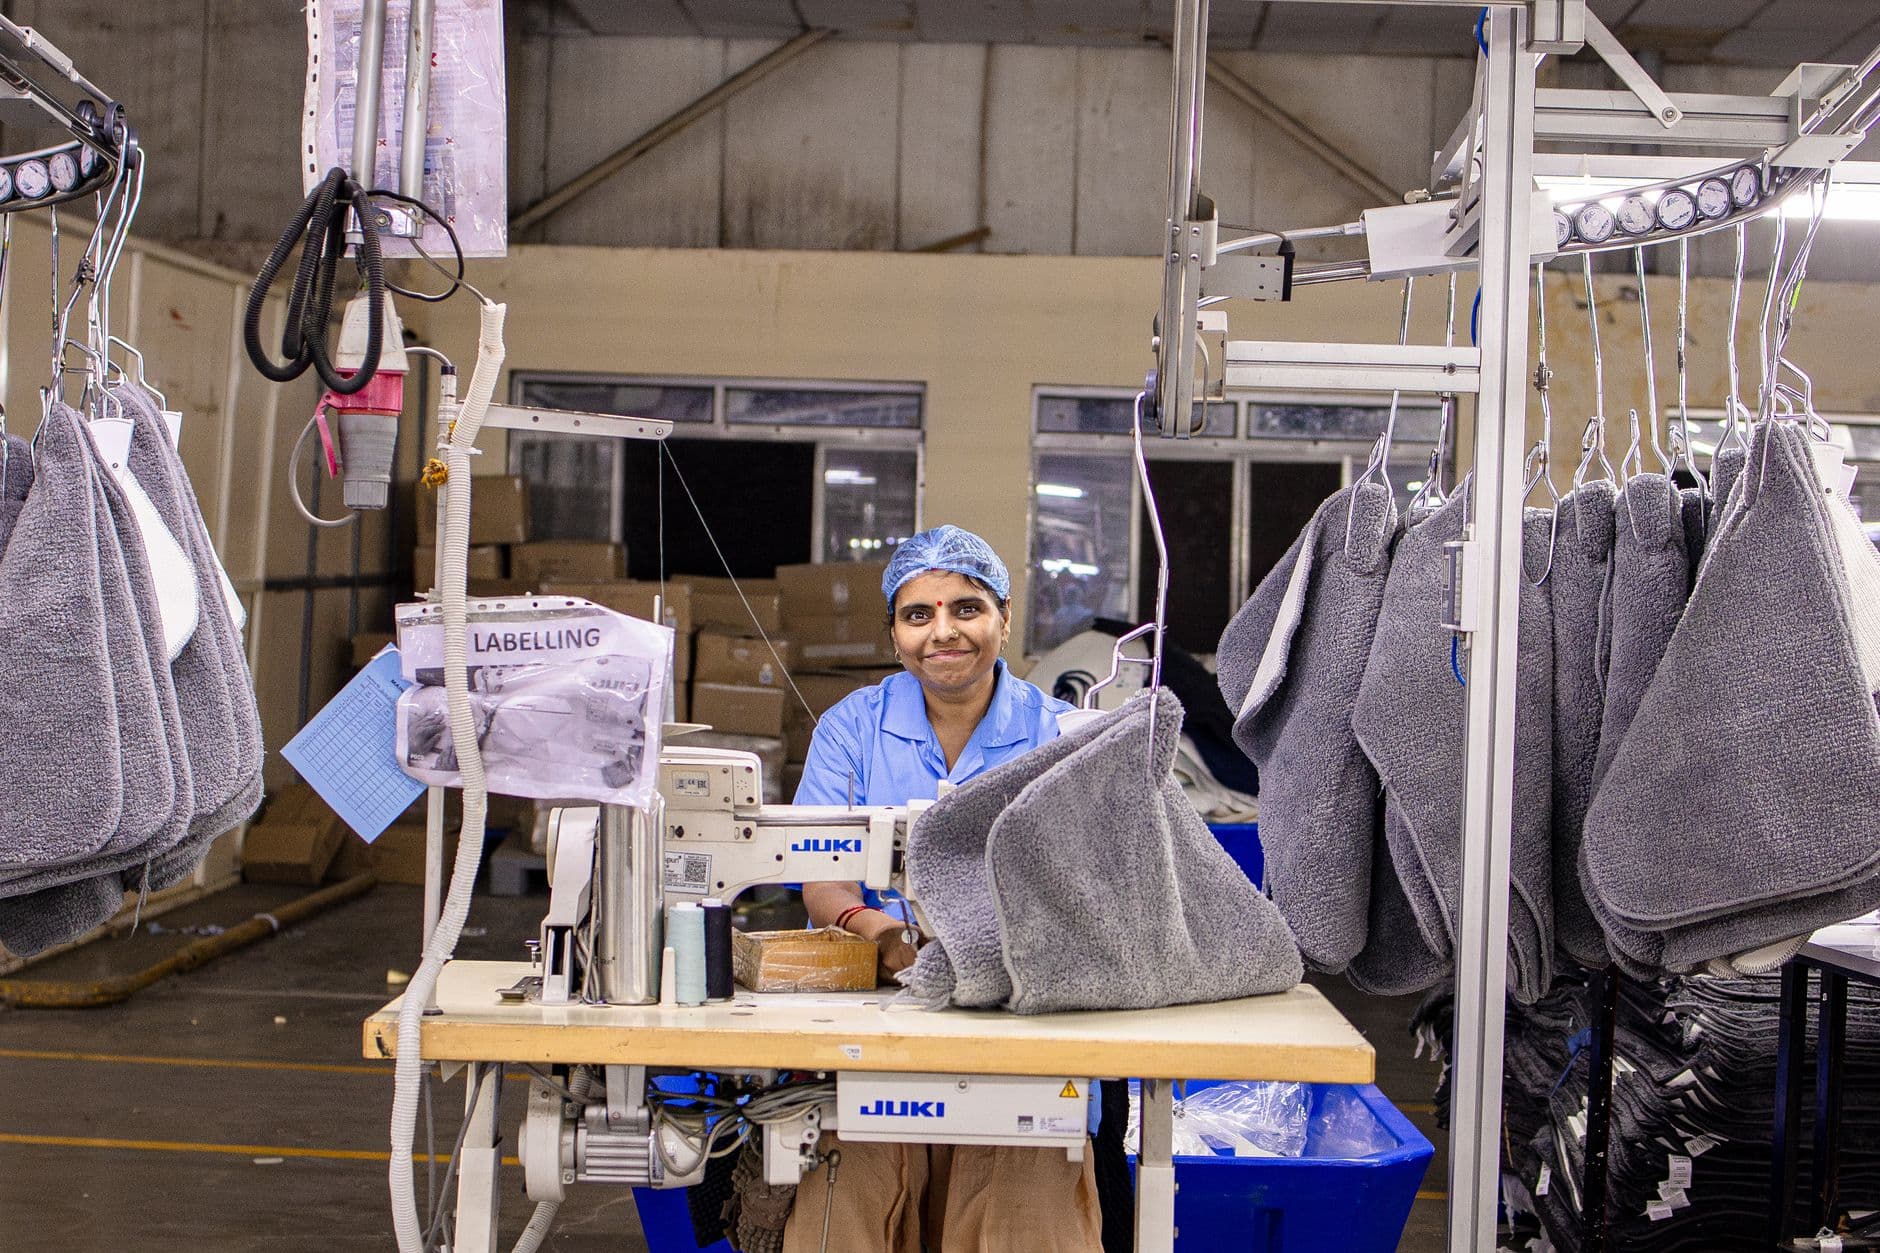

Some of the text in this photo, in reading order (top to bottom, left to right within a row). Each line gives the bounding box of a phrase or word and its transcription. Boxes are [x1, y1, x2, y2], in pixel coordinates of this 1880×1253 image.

[474, 628, 600, 653] LABELLING
[791, 838, 863, 853] JUKI
[859, 1099, 945, 1118] JUKI
